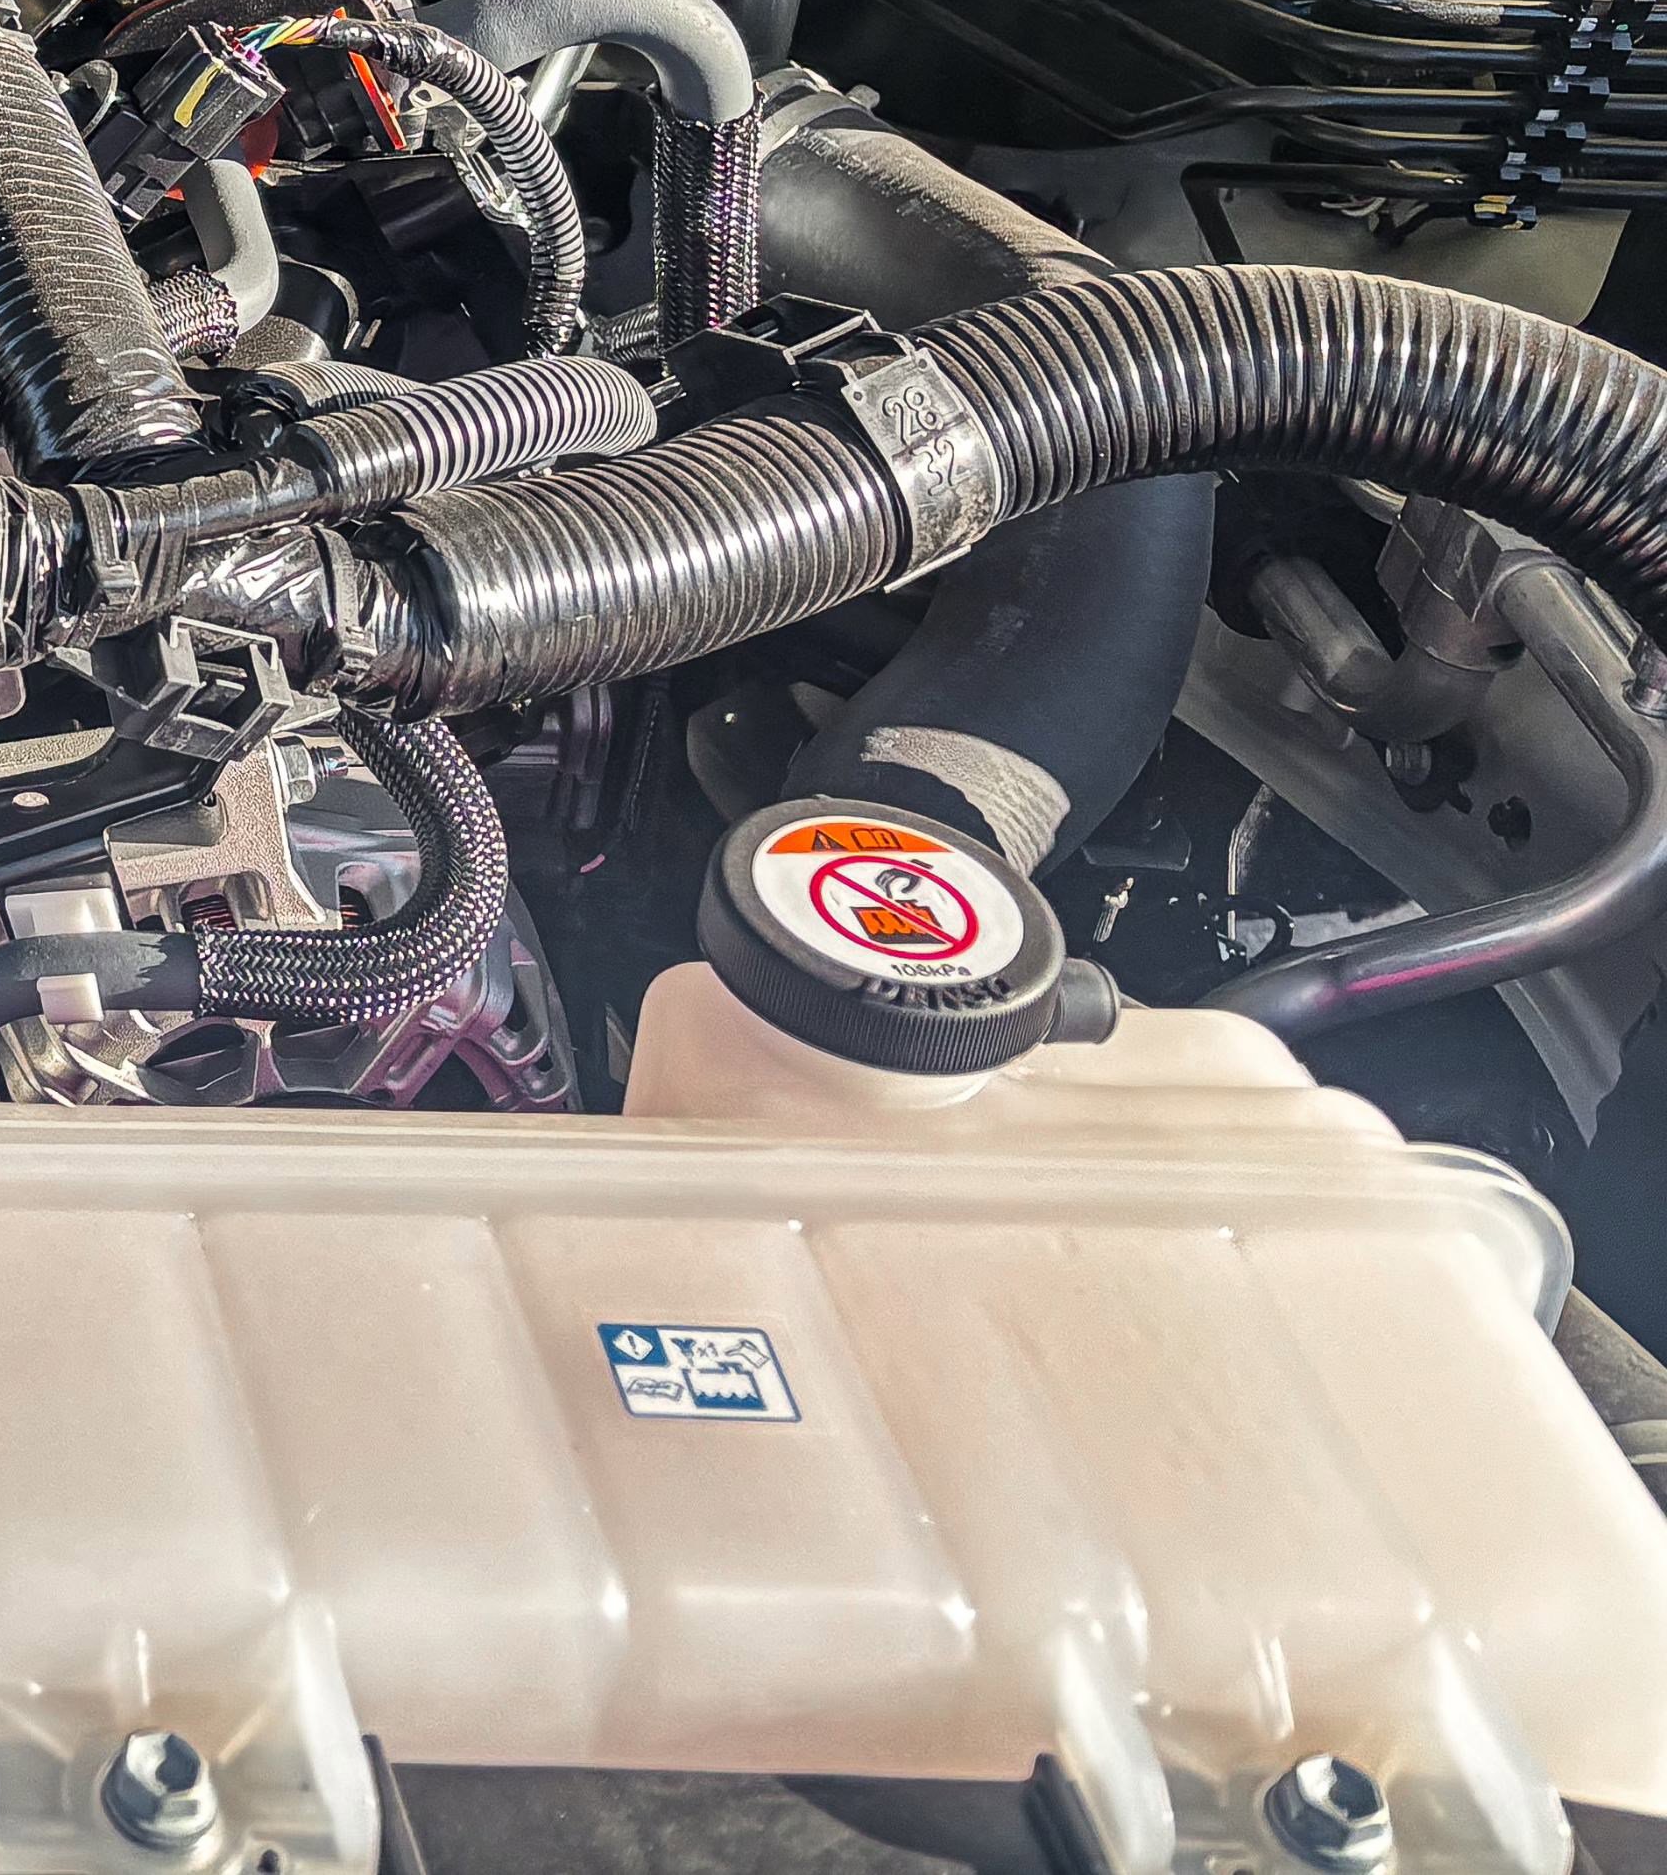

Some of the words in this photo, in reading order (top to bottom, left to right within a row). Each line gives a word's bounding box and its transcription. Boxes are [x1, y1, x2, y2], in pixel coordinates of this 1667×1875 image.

[882, 386, 944, 447] 28
[911, 436, 971, 496] 32
[890, 963, 972, 978] 108kPa
